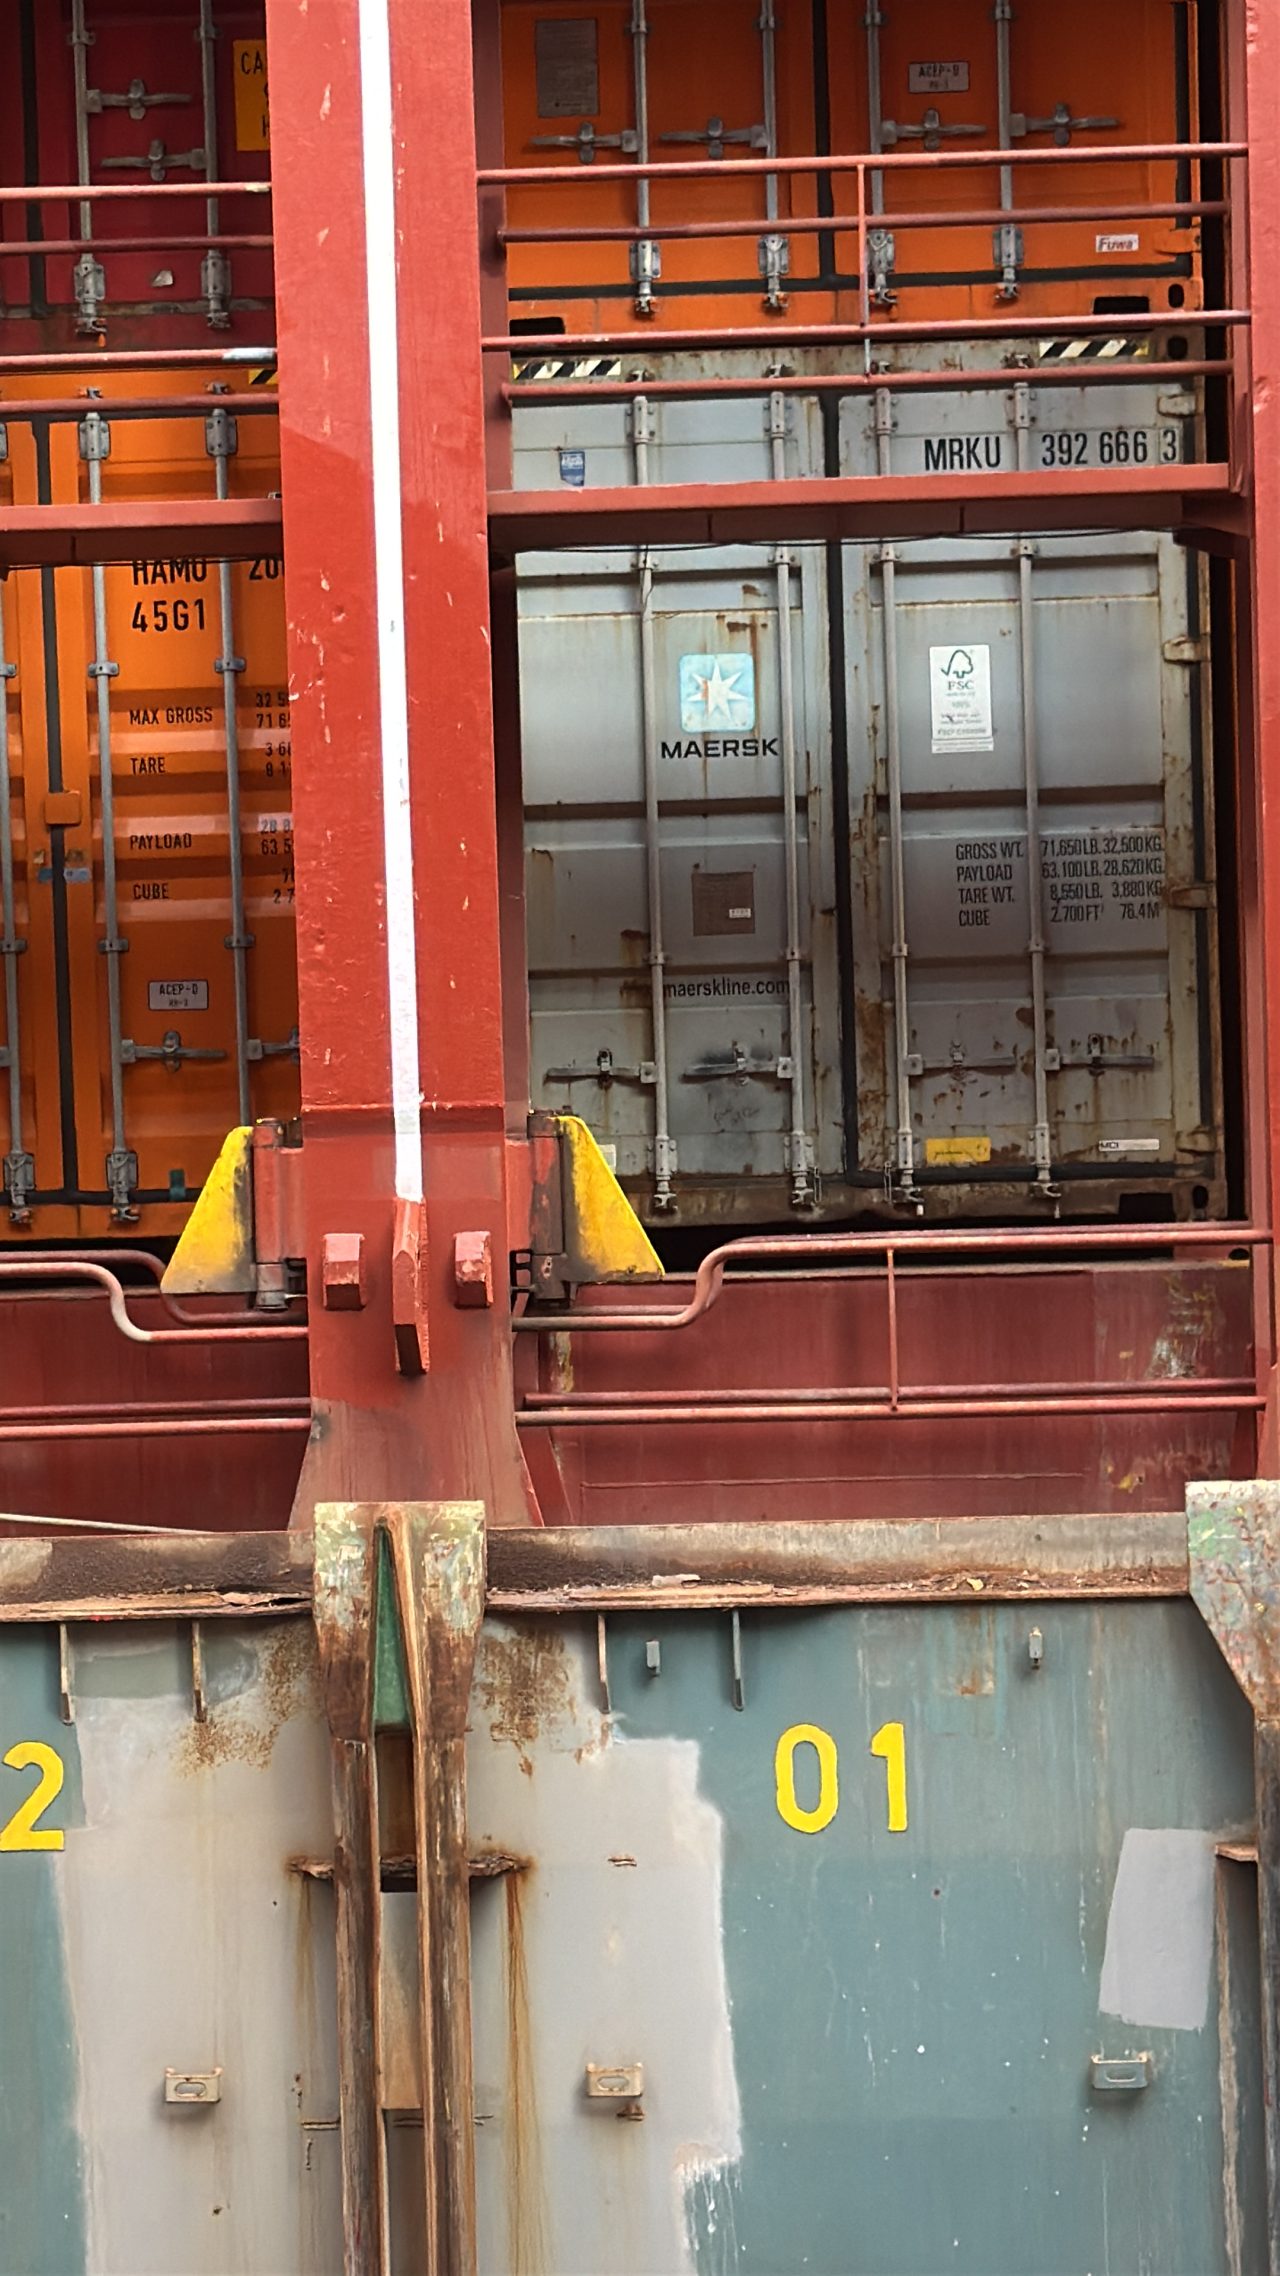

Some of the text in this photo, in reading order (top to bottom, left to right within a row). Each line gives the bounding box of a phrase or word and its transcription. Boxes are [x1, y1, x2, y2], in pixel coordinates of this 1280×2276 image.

[924, 429, 1177, 471] MRKU 392 666 3
[132, 598, 205, 632] 45G1
[948, 681, 974, 691] FSC
[129, 708, 160, 725] MAX
[166, 706, 213, 724] GROSS
[278, 691, 289, 707] 5
[661, 738, 779, 759] MAERSK
[130, 756, 166, 776] TARE
[130, 833, 192, 850] PAYLOAD
[956, 842, 997, 861] GROSS
[957, 864, 1013, 882] PAYLOAD
[133, 883, 169, 900] CUBE
[958, 887, 988, 904] TARE
[959, 909, 990, 926] CUBE
[663, 976, 790, 998] maerskline.com
[775, 1722, 908, 1834] 01
[0, 1741, 64, 1852] 2
